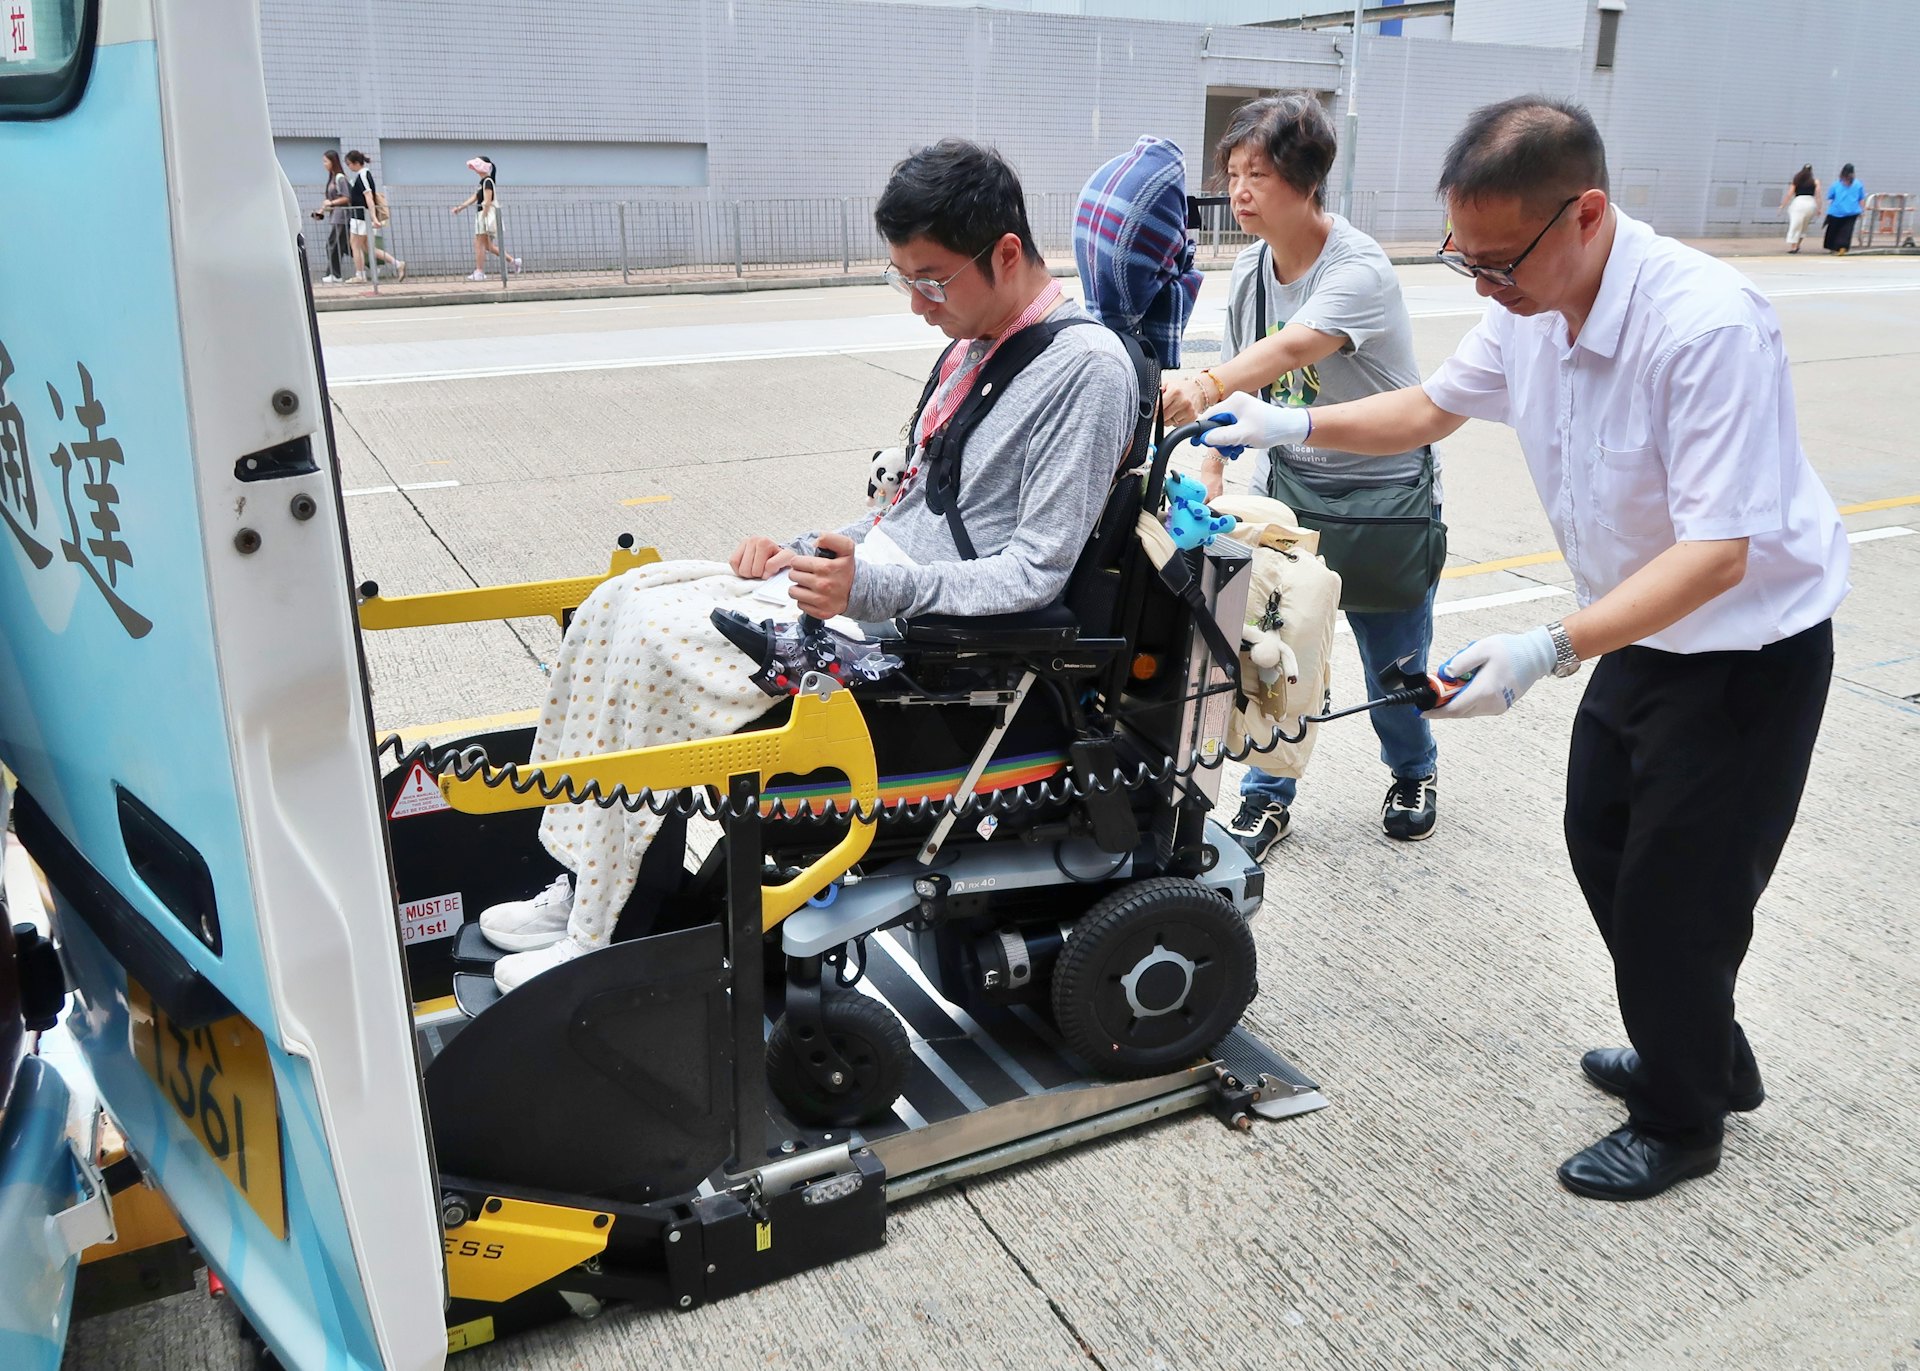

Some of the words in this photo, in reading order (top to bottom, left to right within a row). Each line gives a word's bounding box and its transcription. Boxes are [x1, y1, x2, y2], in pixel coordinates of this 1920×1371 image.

[11, 6, 28, 54] 拉
[1292, 444, 1315, 454] local
[406, 900, 442, 921] MUST
[444, 897, 460, 912] BE
[417, 919, 447, 937] 1st!
